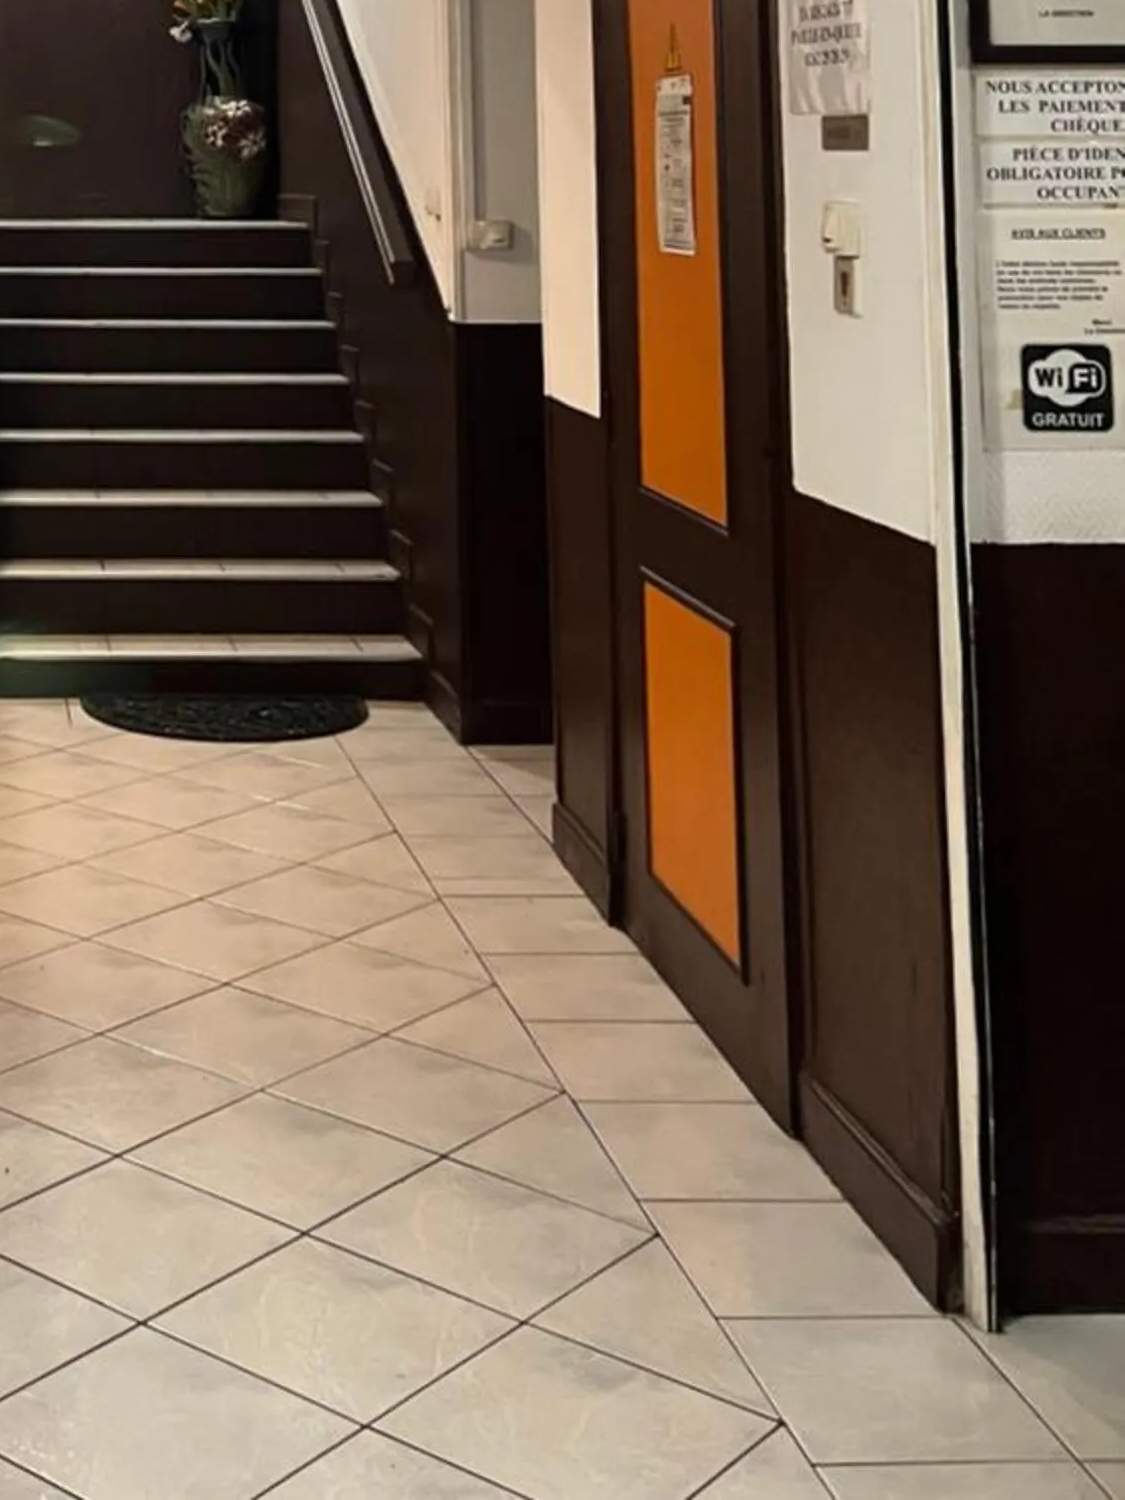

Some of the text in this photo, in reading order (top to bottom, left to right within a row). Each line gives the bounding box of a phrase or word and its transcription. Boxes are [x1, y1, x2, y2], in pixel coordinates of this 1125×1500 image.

[986, 80, 1032, 94] NOUS
[998, 99, 1030, 113] LES
[1013, 145, 1062, 161] PIÈCE
[986, 166, 1106, 181] OBLIGATOIRE
[1031, 412, 1105, 428] GRATUIT
